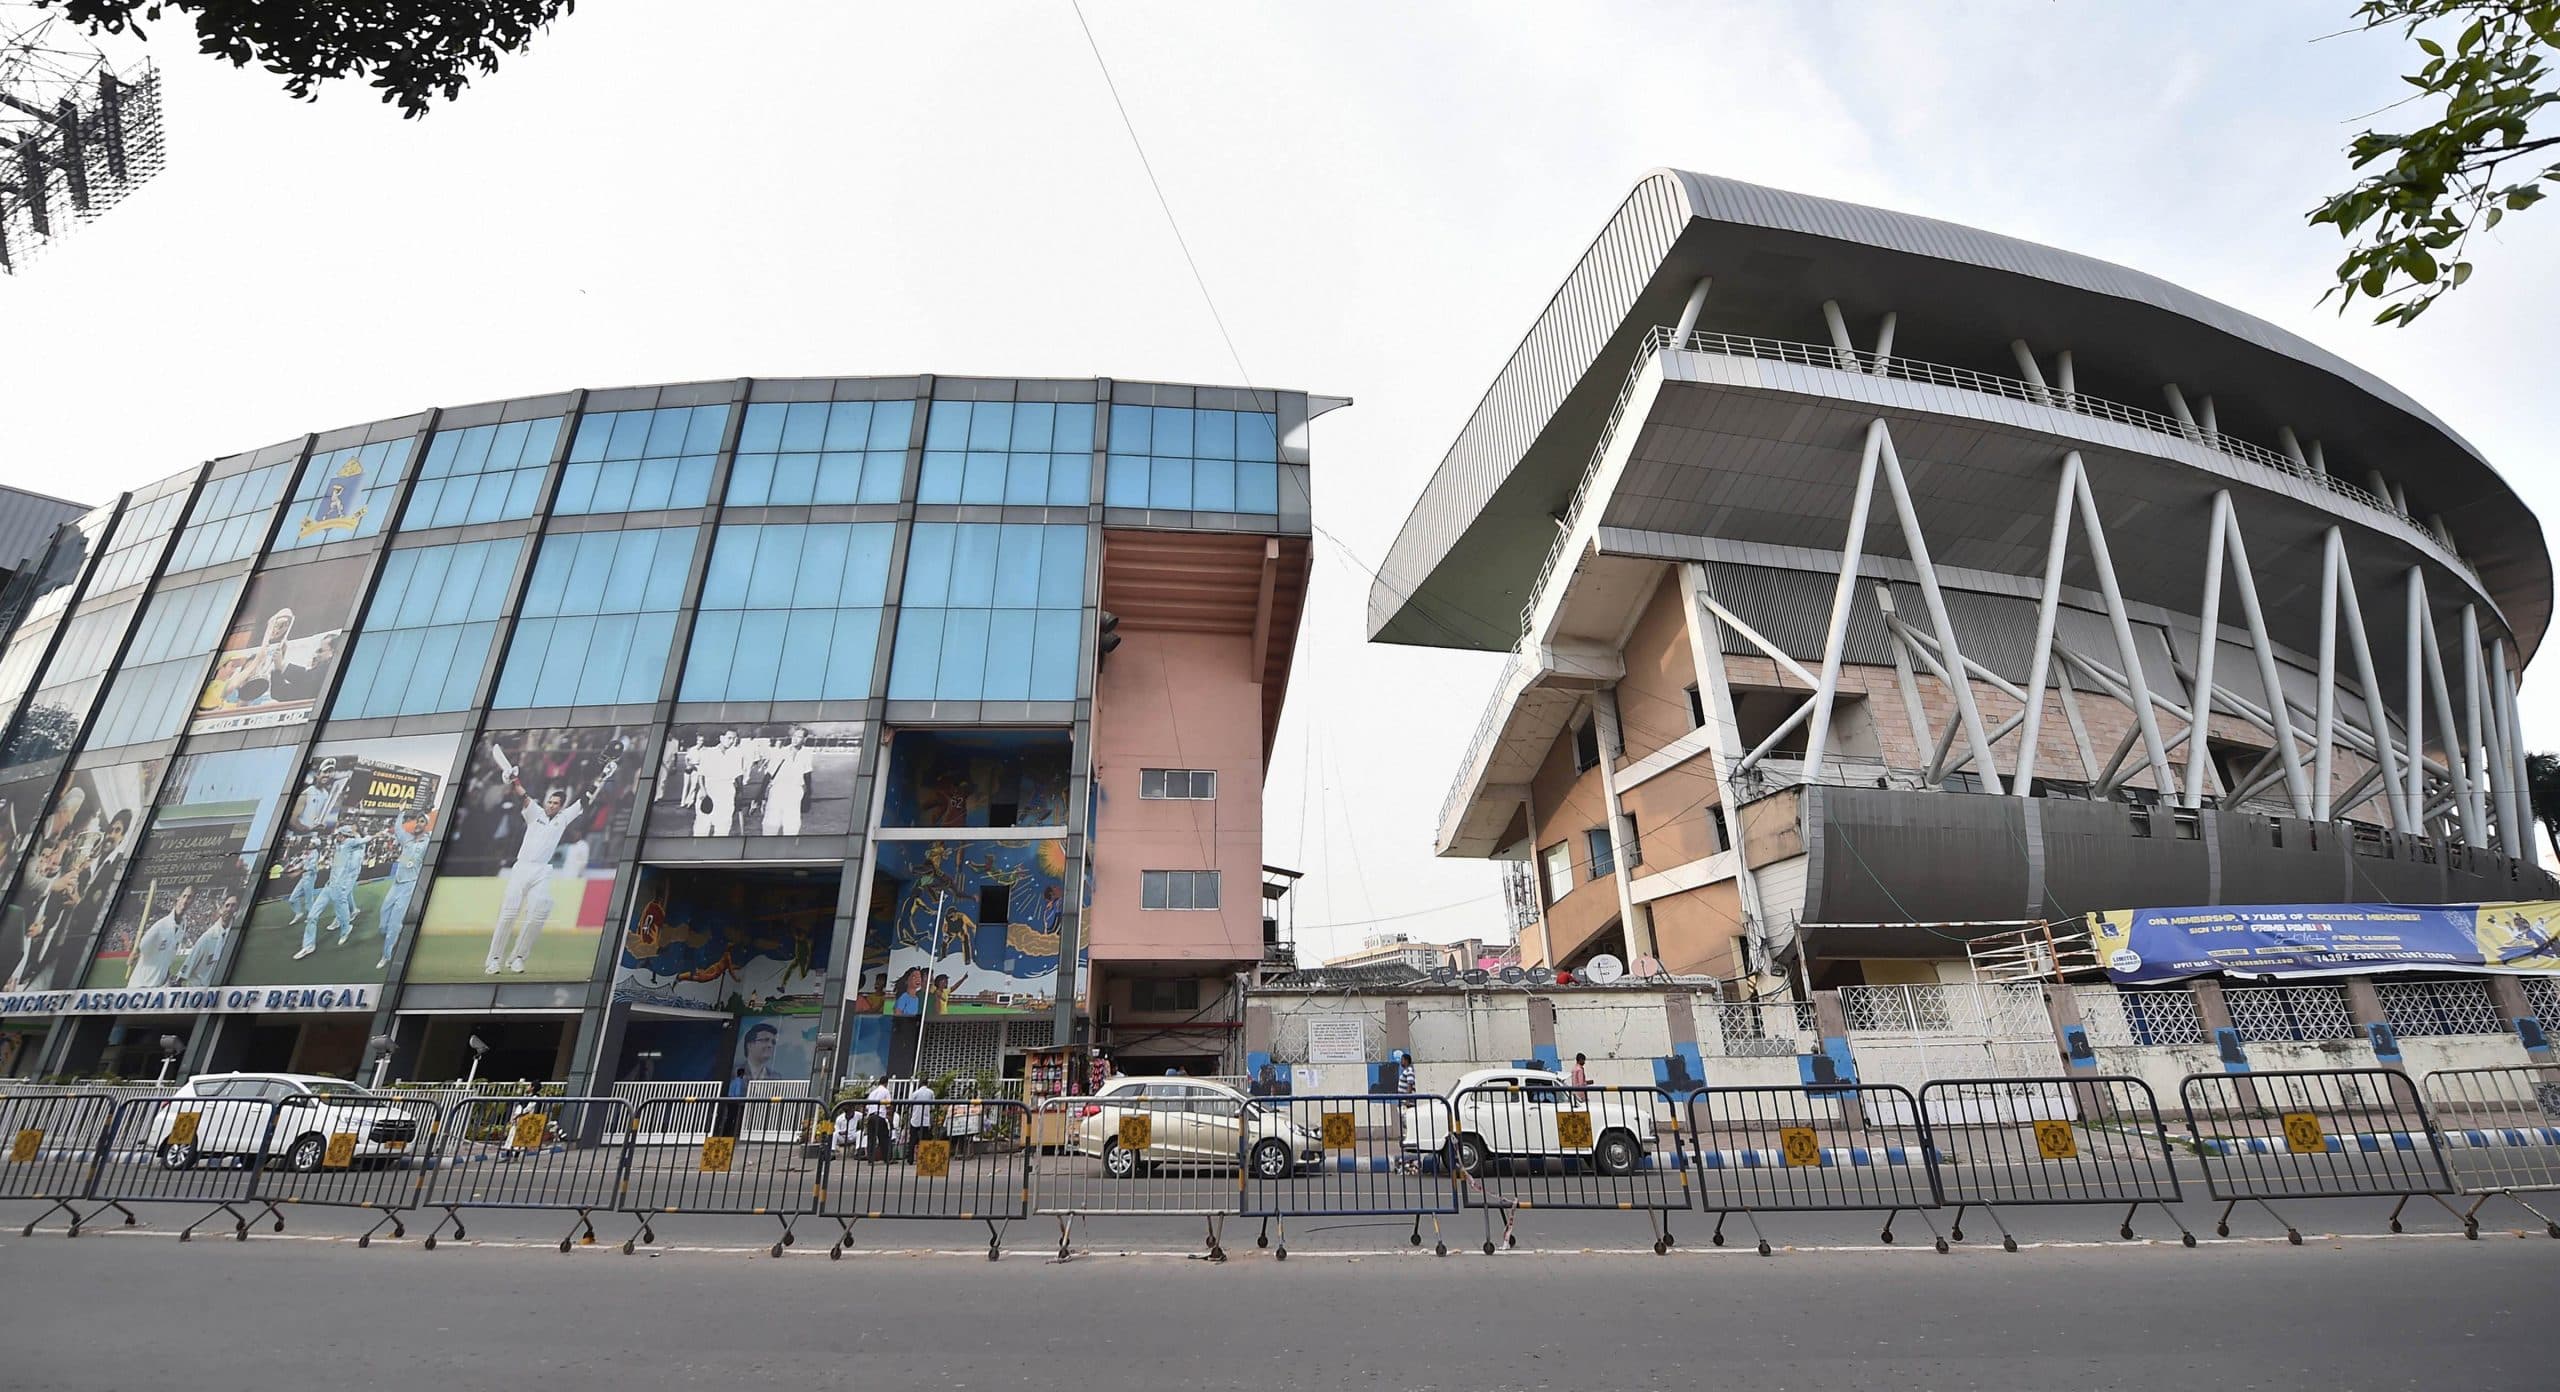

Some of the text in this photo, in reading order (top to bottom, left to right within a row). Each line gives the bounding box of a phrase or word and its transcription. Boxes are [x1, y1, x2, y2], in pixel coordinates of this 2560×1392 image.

[368, 780, 416, 799] INDIA
[2148, 918, 2169, 926] ONE
[2188, 926, 2210, 934] SIGN
[2250, 924, 2285, 933] PRIME
[2112, 955, 2138, 963] LIMITED
[2315, 953, 2350, 963] 74392
[74, 990, 220, 1011] ASSOCIATION
[227, 990, 259, 1009] OF
[264, 989, 368, 1010] BENGAL
